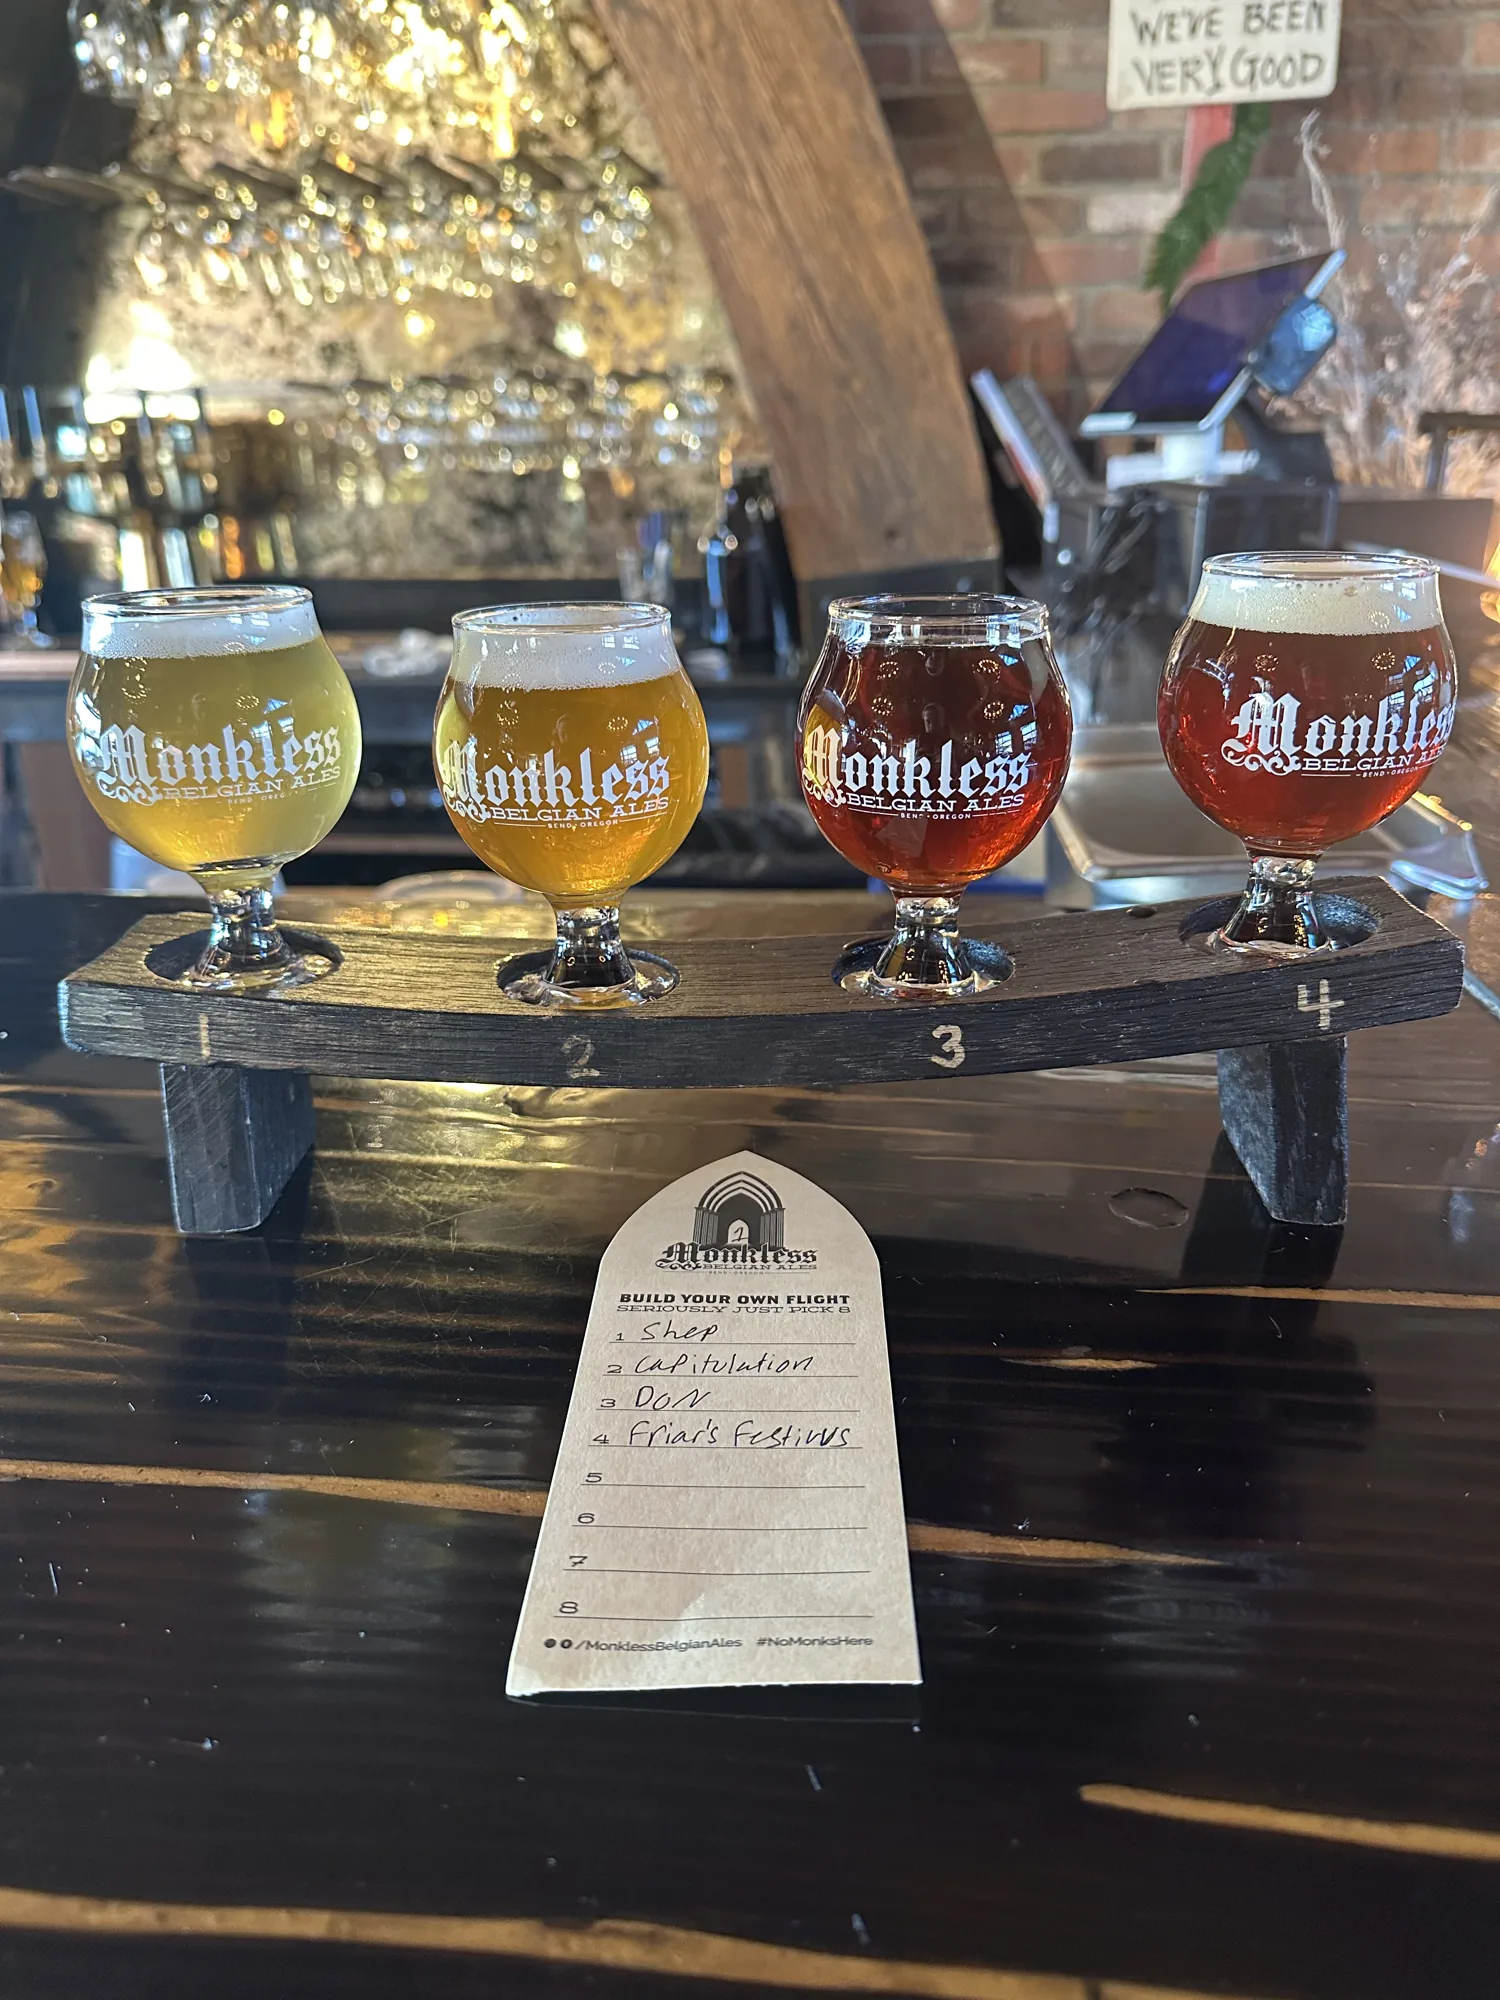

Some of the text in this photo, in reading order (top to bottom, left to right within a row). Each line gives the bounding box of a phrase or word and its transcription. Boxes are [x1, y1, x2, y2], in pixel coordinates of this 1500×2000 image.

[1129, 0, 1325, 45] WE'VE BEEN
[1131, 45, 1324, 96] VERY GOOD
[1221, 691, 1455, 776] Monkless
[96, 723, 341, 806] Monkless
[801, 724, 1032, 807] Monkless
[1302, 754, 1413, 772] BELGIAN
[163, 766, 341, 800] BELGIAN ALES
[442, 739, 670, 823] Monkless
[490, 796, 670, 822] BELGIAN ALES
[846, 792, 1025, 812] BELGIAN ALES
[580, 819, 618, 828] OREGON
[1297, 978, 1345, 1031] 4
[201, 1013, 211, 1058] 1
[561, 1033, 600, 1079] 2
[930, 1024, 965, 1069] 3
[655, 1241, 818, 1270] Monkless
[619, 1293, 850, 1305] BUILD YOUR OWN FLIGHT
[616, 1305, 851, 1314] SERIOUSLY JUST PICK 8
[615, 1332, 625, 1341] 1
[606, 1364, 623, 1374] 2
[600, 1398, 616, 1408] 3
[592, 1433, 610, 1444] 4
[585, 1472, 602, 1483] 5
[577, 1512, 595, 1524] 6
[568, 1555, 588, 1567] 7
[559, 1601, 578, 1614] 8
[755, 1635, 874, 1648] #NoMonksHere
